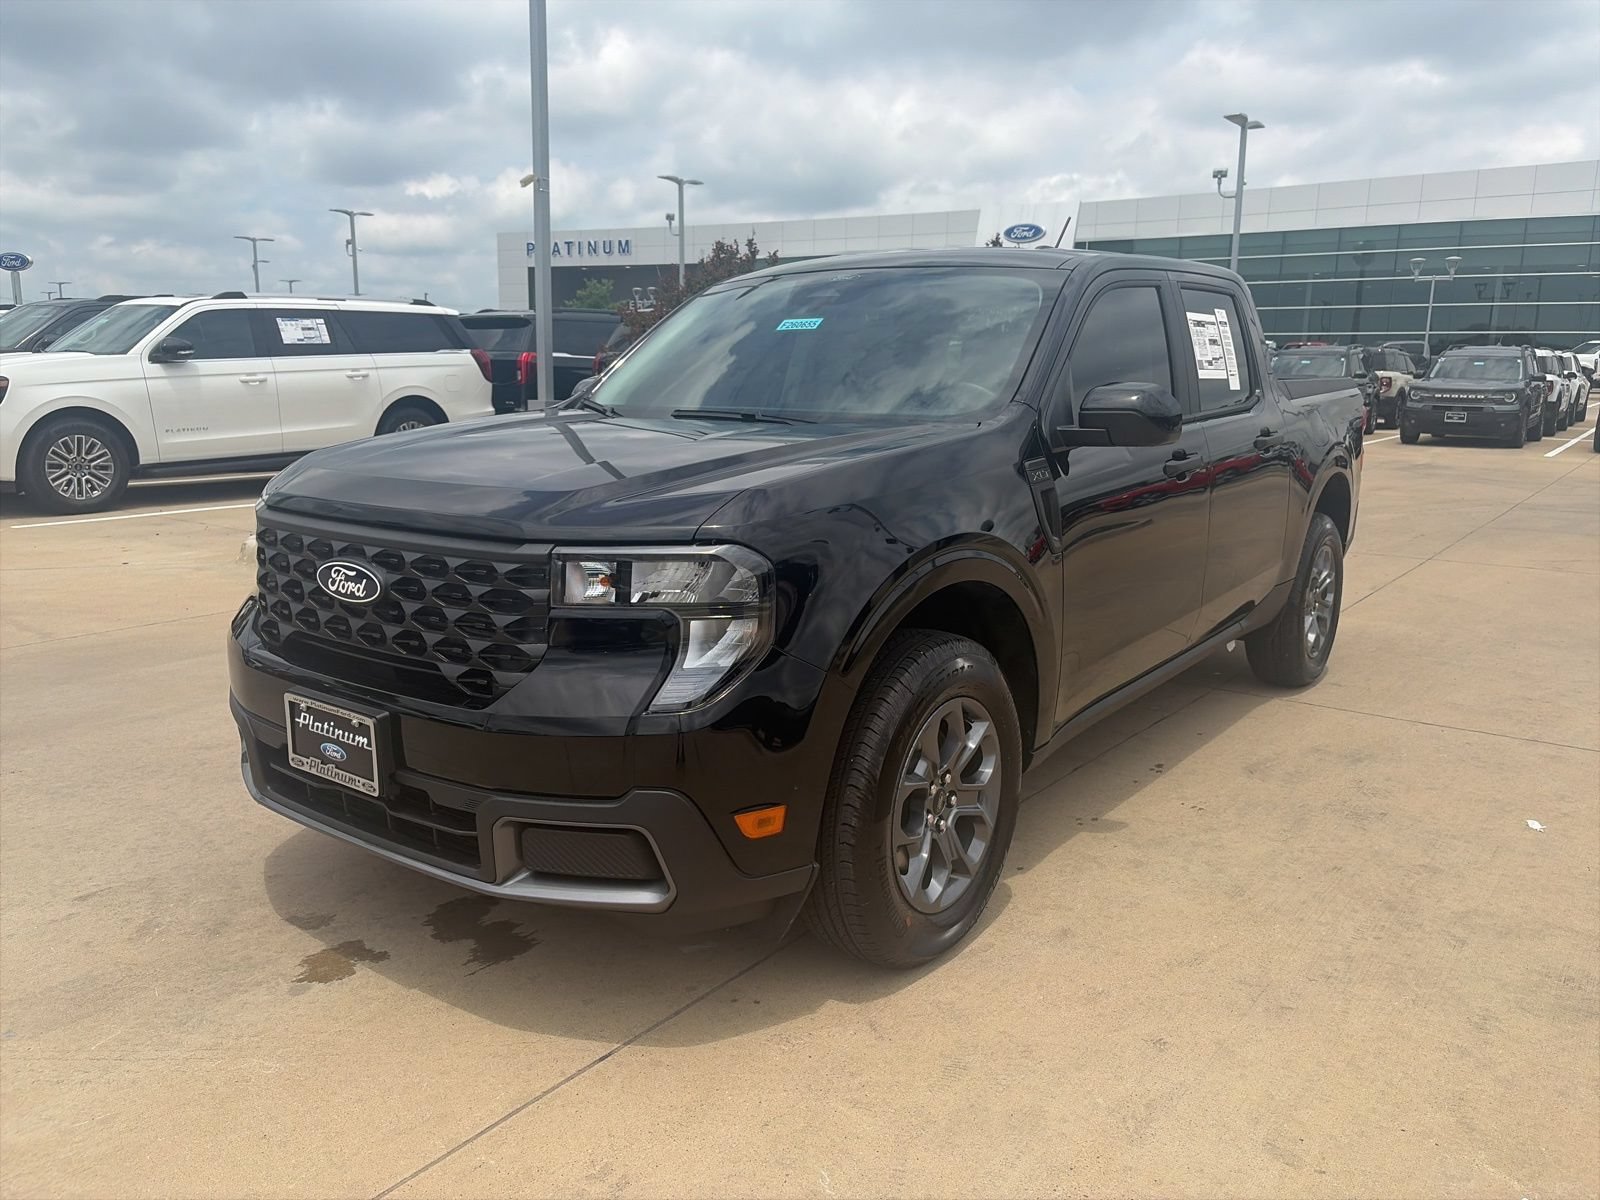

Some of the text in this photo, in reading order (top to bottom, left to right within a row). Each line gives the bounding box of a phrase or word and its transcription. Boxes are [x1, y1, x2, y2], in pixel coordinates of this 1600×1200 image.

[1011, 226, 1035, 238] Ford
[526, 239, 632, 257] PATINUM
[1, 255, 22, 267] Ford
[327, 565, 367, 598] Ford
[295, 711, 372, 751] Platinum
[325, 744, 342, 760] Ford
[309, 759, 360, 787] Platinum
